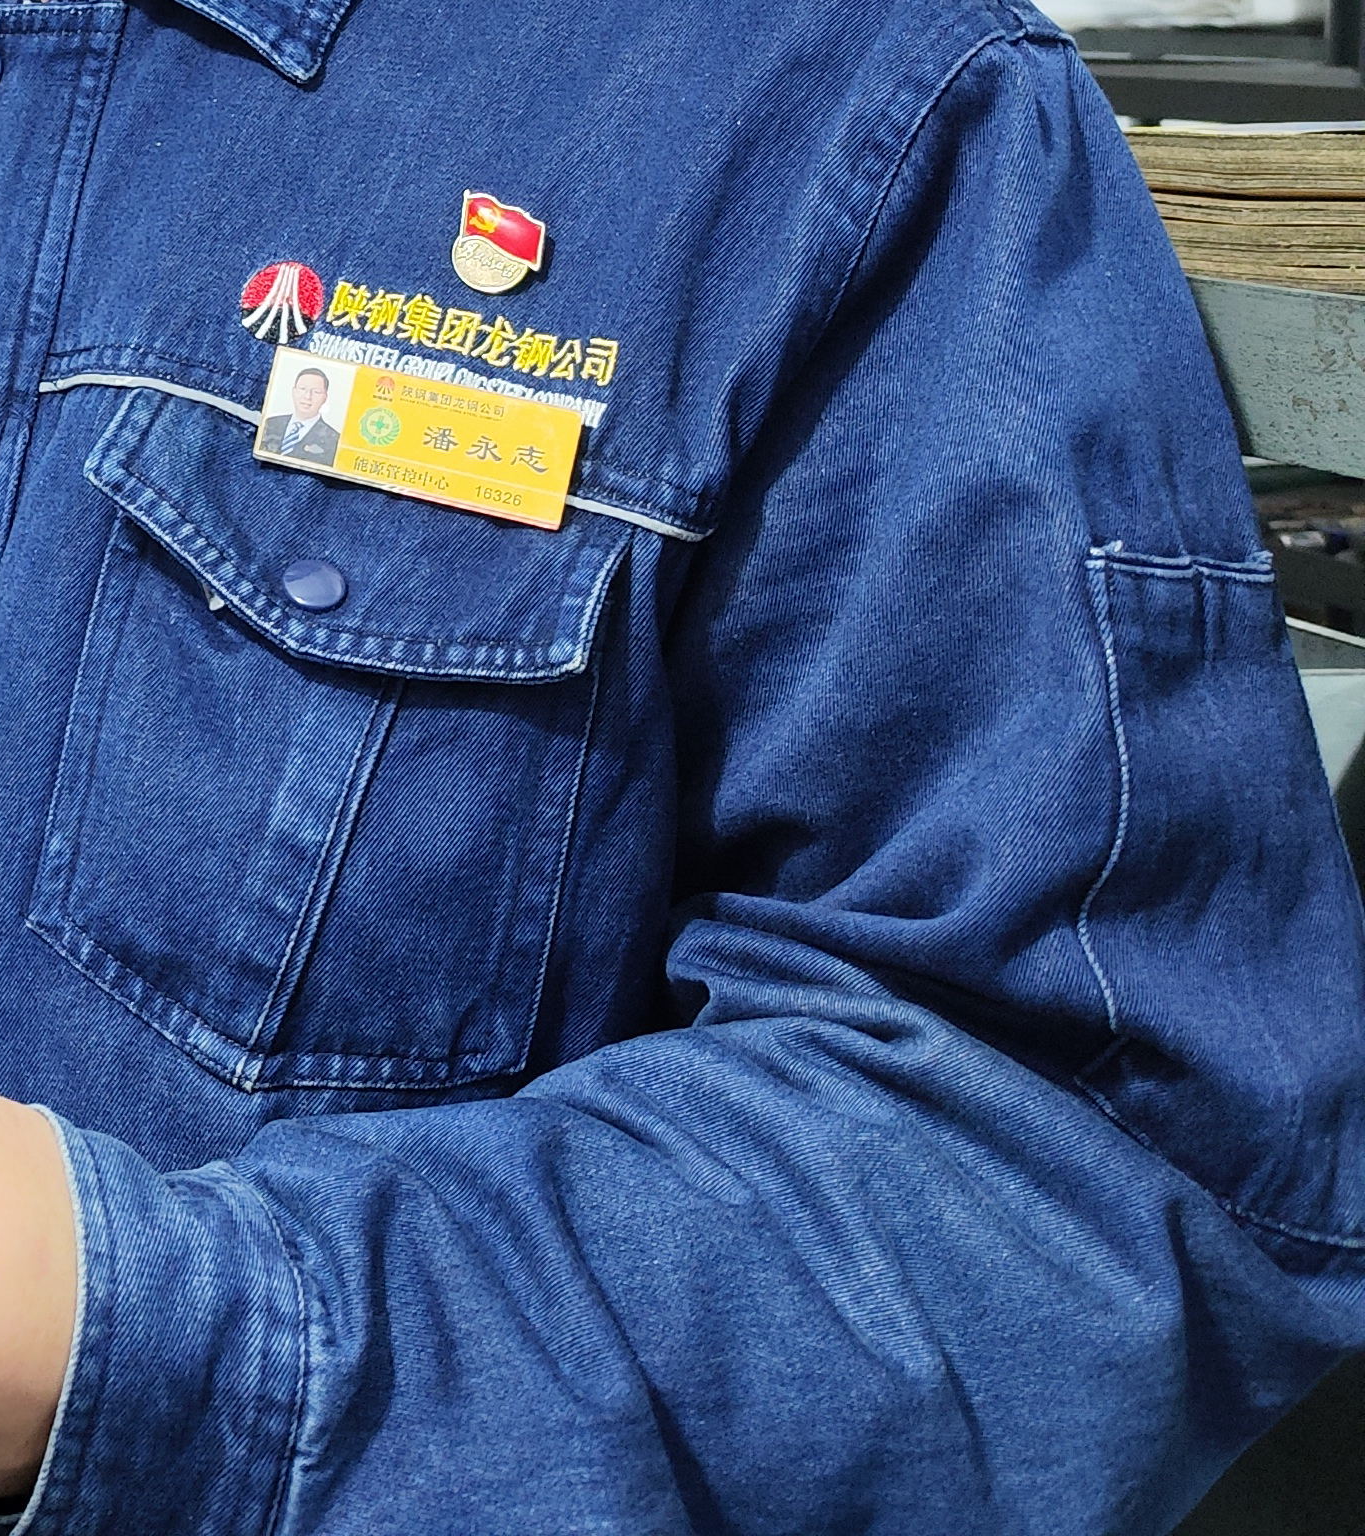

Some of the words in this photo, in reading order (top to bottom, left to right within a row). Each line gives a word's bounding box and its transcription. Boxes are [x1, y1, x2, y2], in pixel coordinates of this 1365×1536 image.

[326, 280, 620, 386] 陕钢集团龙钢公司
[423, 426, 549, 474] 潘永志
[353, 455, 449, 490] 能源管控中心
[475, 485, 522, 507] 16326
